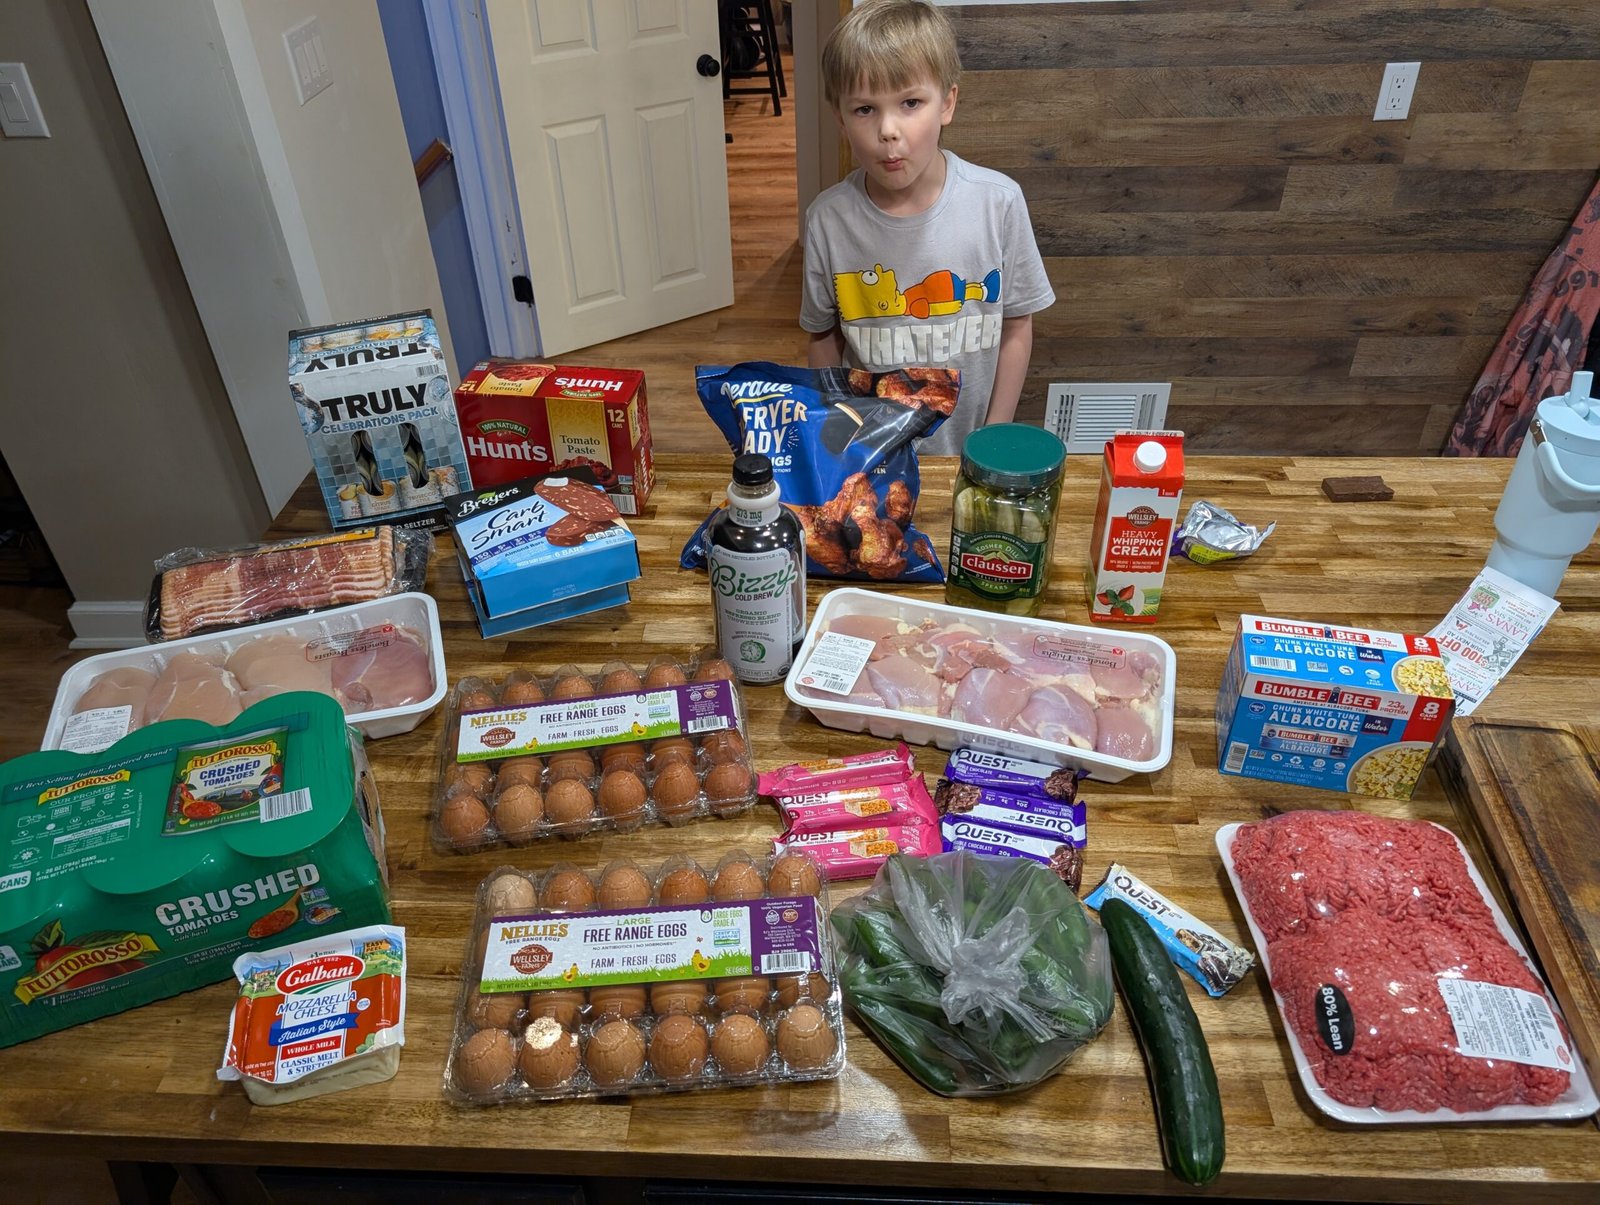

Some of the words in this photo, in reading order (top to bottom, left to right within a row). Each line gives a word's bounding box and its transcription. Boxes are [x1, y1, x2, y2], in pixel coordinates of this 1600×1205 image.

[841, 313, 1003, 366] WHATEVER
[304, 343, 427, 373] TRULY
[458, 383, 477, 391] 12
[320, 383, 427, 421] TRULY
[321, 415, 406, 434] CELEBRATIONS
[408, 406, 439, 419] PACK
[607, 409, 625, 423] 12
[743, 399, 808, 430] FRYER
[482, 420, 497, 431] 100%
[496, 420, 527, 435] NATURAL
[560, 435, 601, 446] Tomato
[744, 426, 787, 455] ADY
[567, 445, 596, 455] Paste
[457, 486, 520, 518] Breyers
[403, 517, 436, 530] SELTZER
[487, 500, 545, 530] Carb
[736, 507, 748, 519] 273
[749, 511, 763, 523] mg
[1127, 513, 1157, 521] WELLSLEY
[471, 513, 546, 550] Smart
[1121, 530, 1158, 539] HEAVY
[504, 544, 530, 557] Almond
[530, 540, 545, 548] Bars
[1112, 537, 1164, 546] WHIPPING
[561, 545, 585, 557] BARS
[975, 543, 1003, 553] KOSHER
[1004, 546, 1020, 559] DILL
[1110, 545, 1162, 557] CREAM
[966, 557, 1027, 575] claussen
[711, 556, 796, 599] Bizzy
[980, 581, 1008, 590] SPEARS
[734, 593, 752, 602] COLD
[753, 590, 774, 601] BREW
[1261, 622, 1322, 636] BUMBLE
[1335, 631, 1366, 642] BEE
[1486, 613, 1529, 641] LANA'S
[1273, 638, 1301, 646] CHUNK
[1302, 641, 1328, 649] WHITE
[1331, 644, 1353, 652] TUNA
[1375, 637, 1392, 645] 23g
[1413, 637, 1429, 648] 8
[1455, 635, 1470, 646] NEXT
[1470, 645, 1486, 654] YOUR
[313, 648, 349, 662] Breasts
[349, 640, 390, 655] Boneless
[1040, 649, 1074, 663] Thighs
[1076, 655, 1117, 669] Boneless
[1273, 644, 1356, 661] ALBACORE
[1359, 652, 1383, 660] Water
[1436, 635, 1462, 652] OFF
[1461, 647, 1488, 668] $100
[1450, 676, 1482, 696] LANA
[1261, 683, 1328, 701] BUMBLE
[1343, 693, 1377, 708] BEE
[567, 702, 596, 711] LARGE
[1272, 704, 1303, 713] CHUNK
[1304, 708, 1334, 717] WHITE
[1337, 712, 1361, 721] TUNA
[1379, 706, 1409, 715] PROTEIN
[1387, 700, 1406, 710] 23g
[1422, 701, 1440, 715] 8
[469, 710, 528, 728] NELLIE'S
[540, 714, 563, 725] FREE
[566, 707, 599, 721] RANGE
[601, 704, 627, 716] EGGS
[1268, 711, 1361, 733] ALBACORE
[547, 730, 568, 740] FARM
[573, 728, 596, 738] FRESH
[600, 725, 619, 734] EGGS
[1364, 722, 1389, 732] Water
[481, 733, 515, 742] WELLSLEY
[1280, 730, 1313, 741] BUMBLE
[1319, 736, 1336, 744] BEE
[193, 742, 273, 769] TUTTOROSSO
[1279, 743, 1329, 755] ALBACORE
[958, 749, 1012, 770] QUEST
[25, 781, 44, 789] Best
[45, 775, 75, 785] Selling
[77, 756, 142, 778] Italian-Inspired
[143, 749, 168, 760] Brand
[199, 759, 262, 781] CRUSHED
[969, 766, 993, 775] CHOCOLATE
[47, 772, 125, 799] TUTTOROSSO
[203, 770, 255, 788] TOMATOES
[50, 796, 71, 807] OUR
[71, 785, 117, 803] PROMISE
[103, 792, 116, 800] GF
[781, 792, 830, 806] QUEST
[1034, 806, 1059, 817] CHOCOLATE
[1015, 813, 1073, 833] QUEST
[787, 831, 835, 844] QUEST
[954, 823, 1014, 845] QUEST
[967, 842, 993, 852] CHOCOLATE
[81, 855, 97, 863] CANS
[0, 875, 28, 890] CANS
[155, 863, 321, 927] CRUSHED
[1113, 875, 1171, 917] QUEST
[616, 917, 652, 926] LARGE
[713, 910, 729, 919] LARGE
[729, 909, 743, 918] EGGS
[166, 909, 240, 937] TOMATOES
[500, 920, 569, 942] NELLIE'S
[713, 919, 730, 927] GRADE
[730, 919, 735, 927] A
[191, 928, 209, 938] basil
[583, 928, 611, 943] FREE
[614, 925, 654, 941] RANGE
[657, 923, 688, 938] EGGS
[365, 941, 383, 949] EASY
[23, 939, 142, 995] TUTTOROSSO
[512, 954, 550, 964] WELLSLEY
[590, 957, 615, 969] FARM
[621, 955, 649, 967] FRESH
[655, 953, 677, 965] EGGS
[285, 962, 356, 988] Galbani
[277, 990, 357, 1015] MOZZARELLA
[1322, 986, 1339, 1017] 80%
[293, 1003, 338, 1020] CHEESE
[278, 1024, 317, 1043] Italian
[317, 1016, 347, 1032] Style
[1327, 1018, 1344, 1051] Lean
[287, 1043, 315, 1055] WHOLE
[315, 1039, 336, 1050] MILK
[281, 1055, 316, 1070] CLASSIC
[316, 1051, 340, 1062] MELT
[287, 1068, 294, 1076] &
